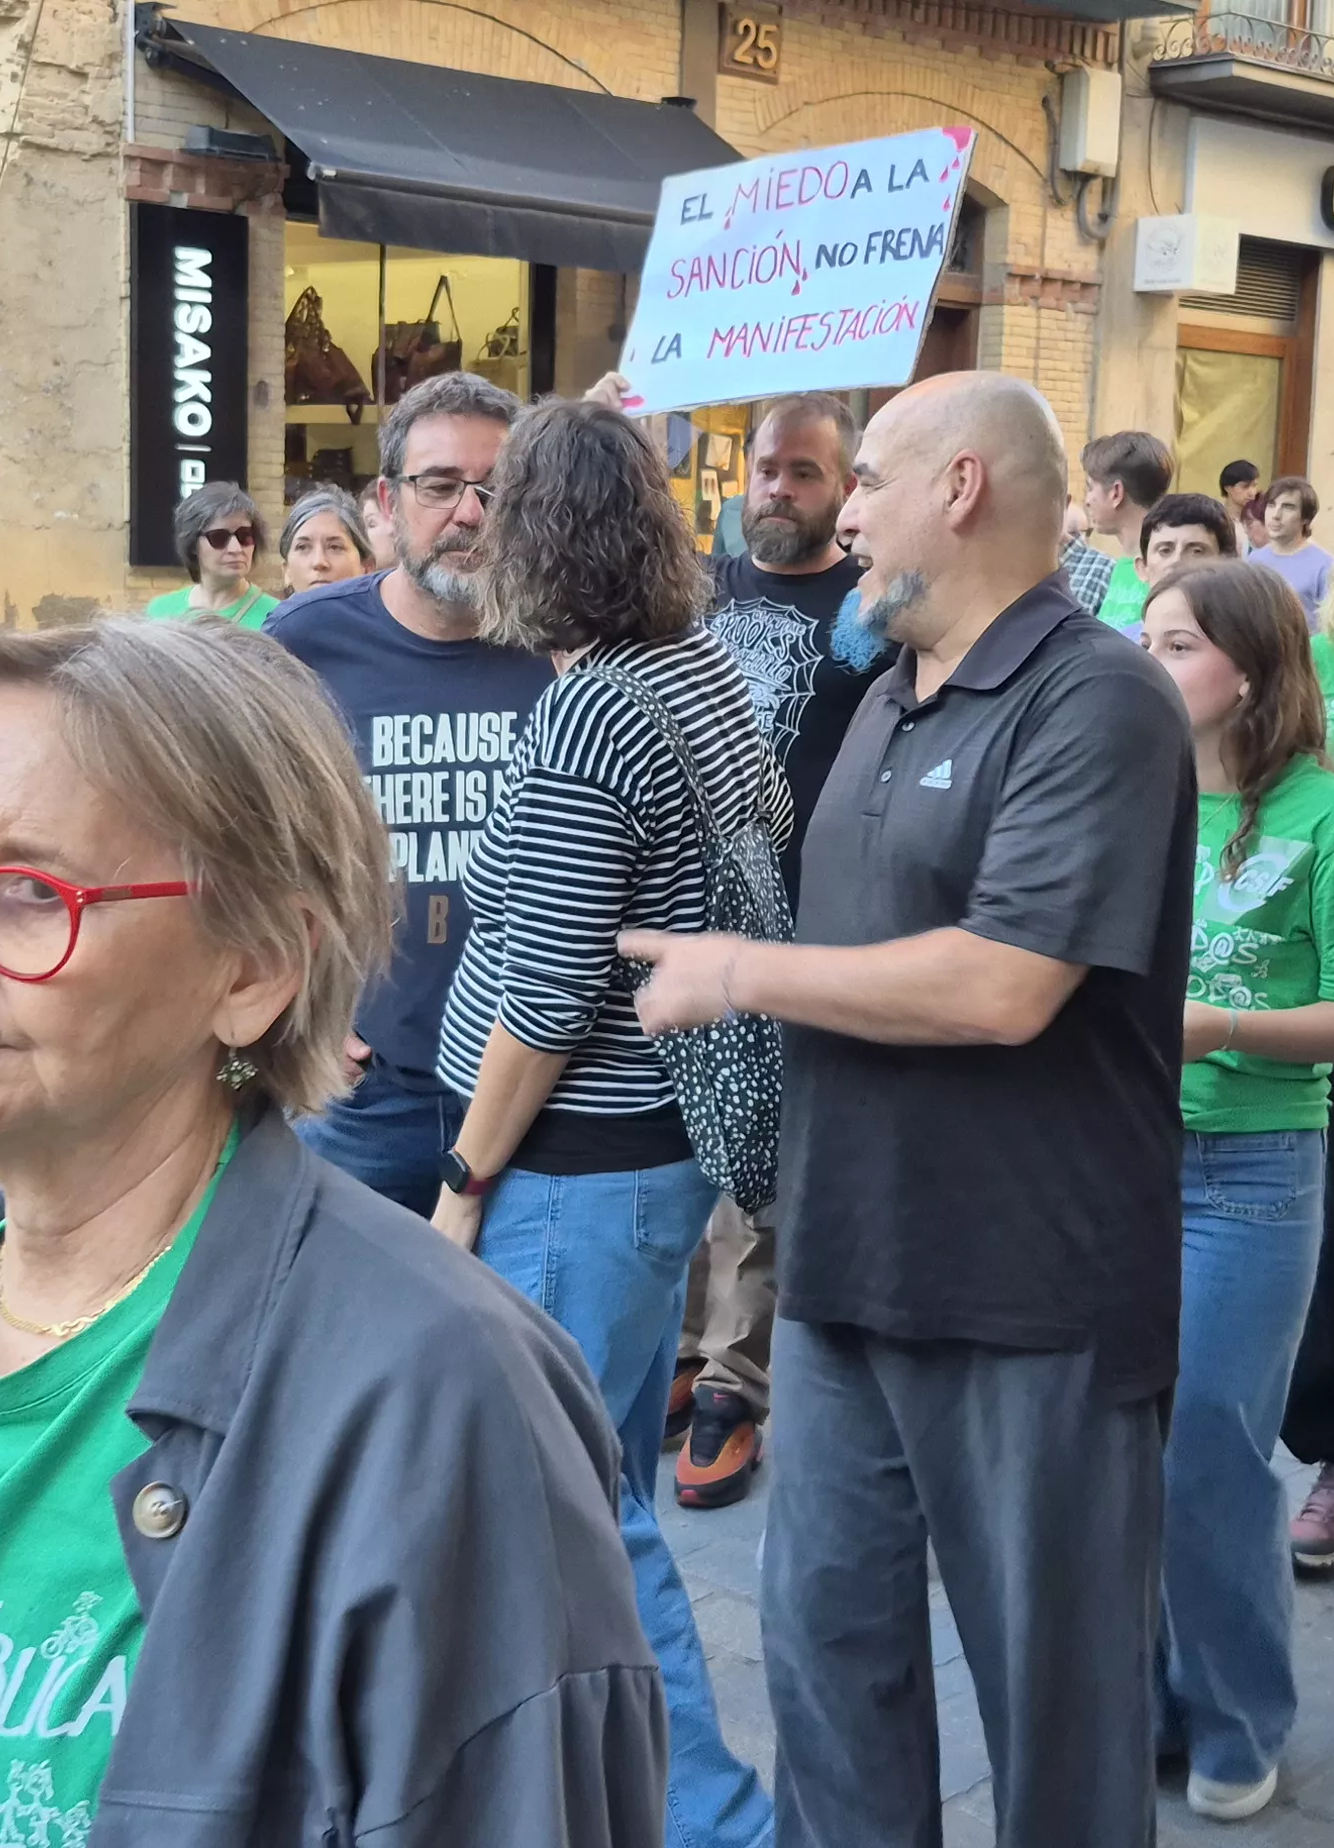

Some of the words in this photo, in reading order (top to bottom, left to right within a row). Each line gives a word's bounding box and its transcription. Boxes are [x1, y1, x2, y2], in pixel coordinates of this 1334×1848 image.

[734, 18, 778, 69] 25
[680, 194, 714, 226] EL
[850, 168, 873, 199] A
[887, 158, 930, 194] LA
[814, 242, 858, 271] NO
[863, 222, 946, 265] FRENA
[174, 245, 213, 437] MISAKO
[650, 332, 683, 365] LA
[372, 711, 517, 767] BECAUSE
[365, 771, 450, 825] HERE
[455, 770, 487, 823] IS
[427, 895, 449, 944] B
